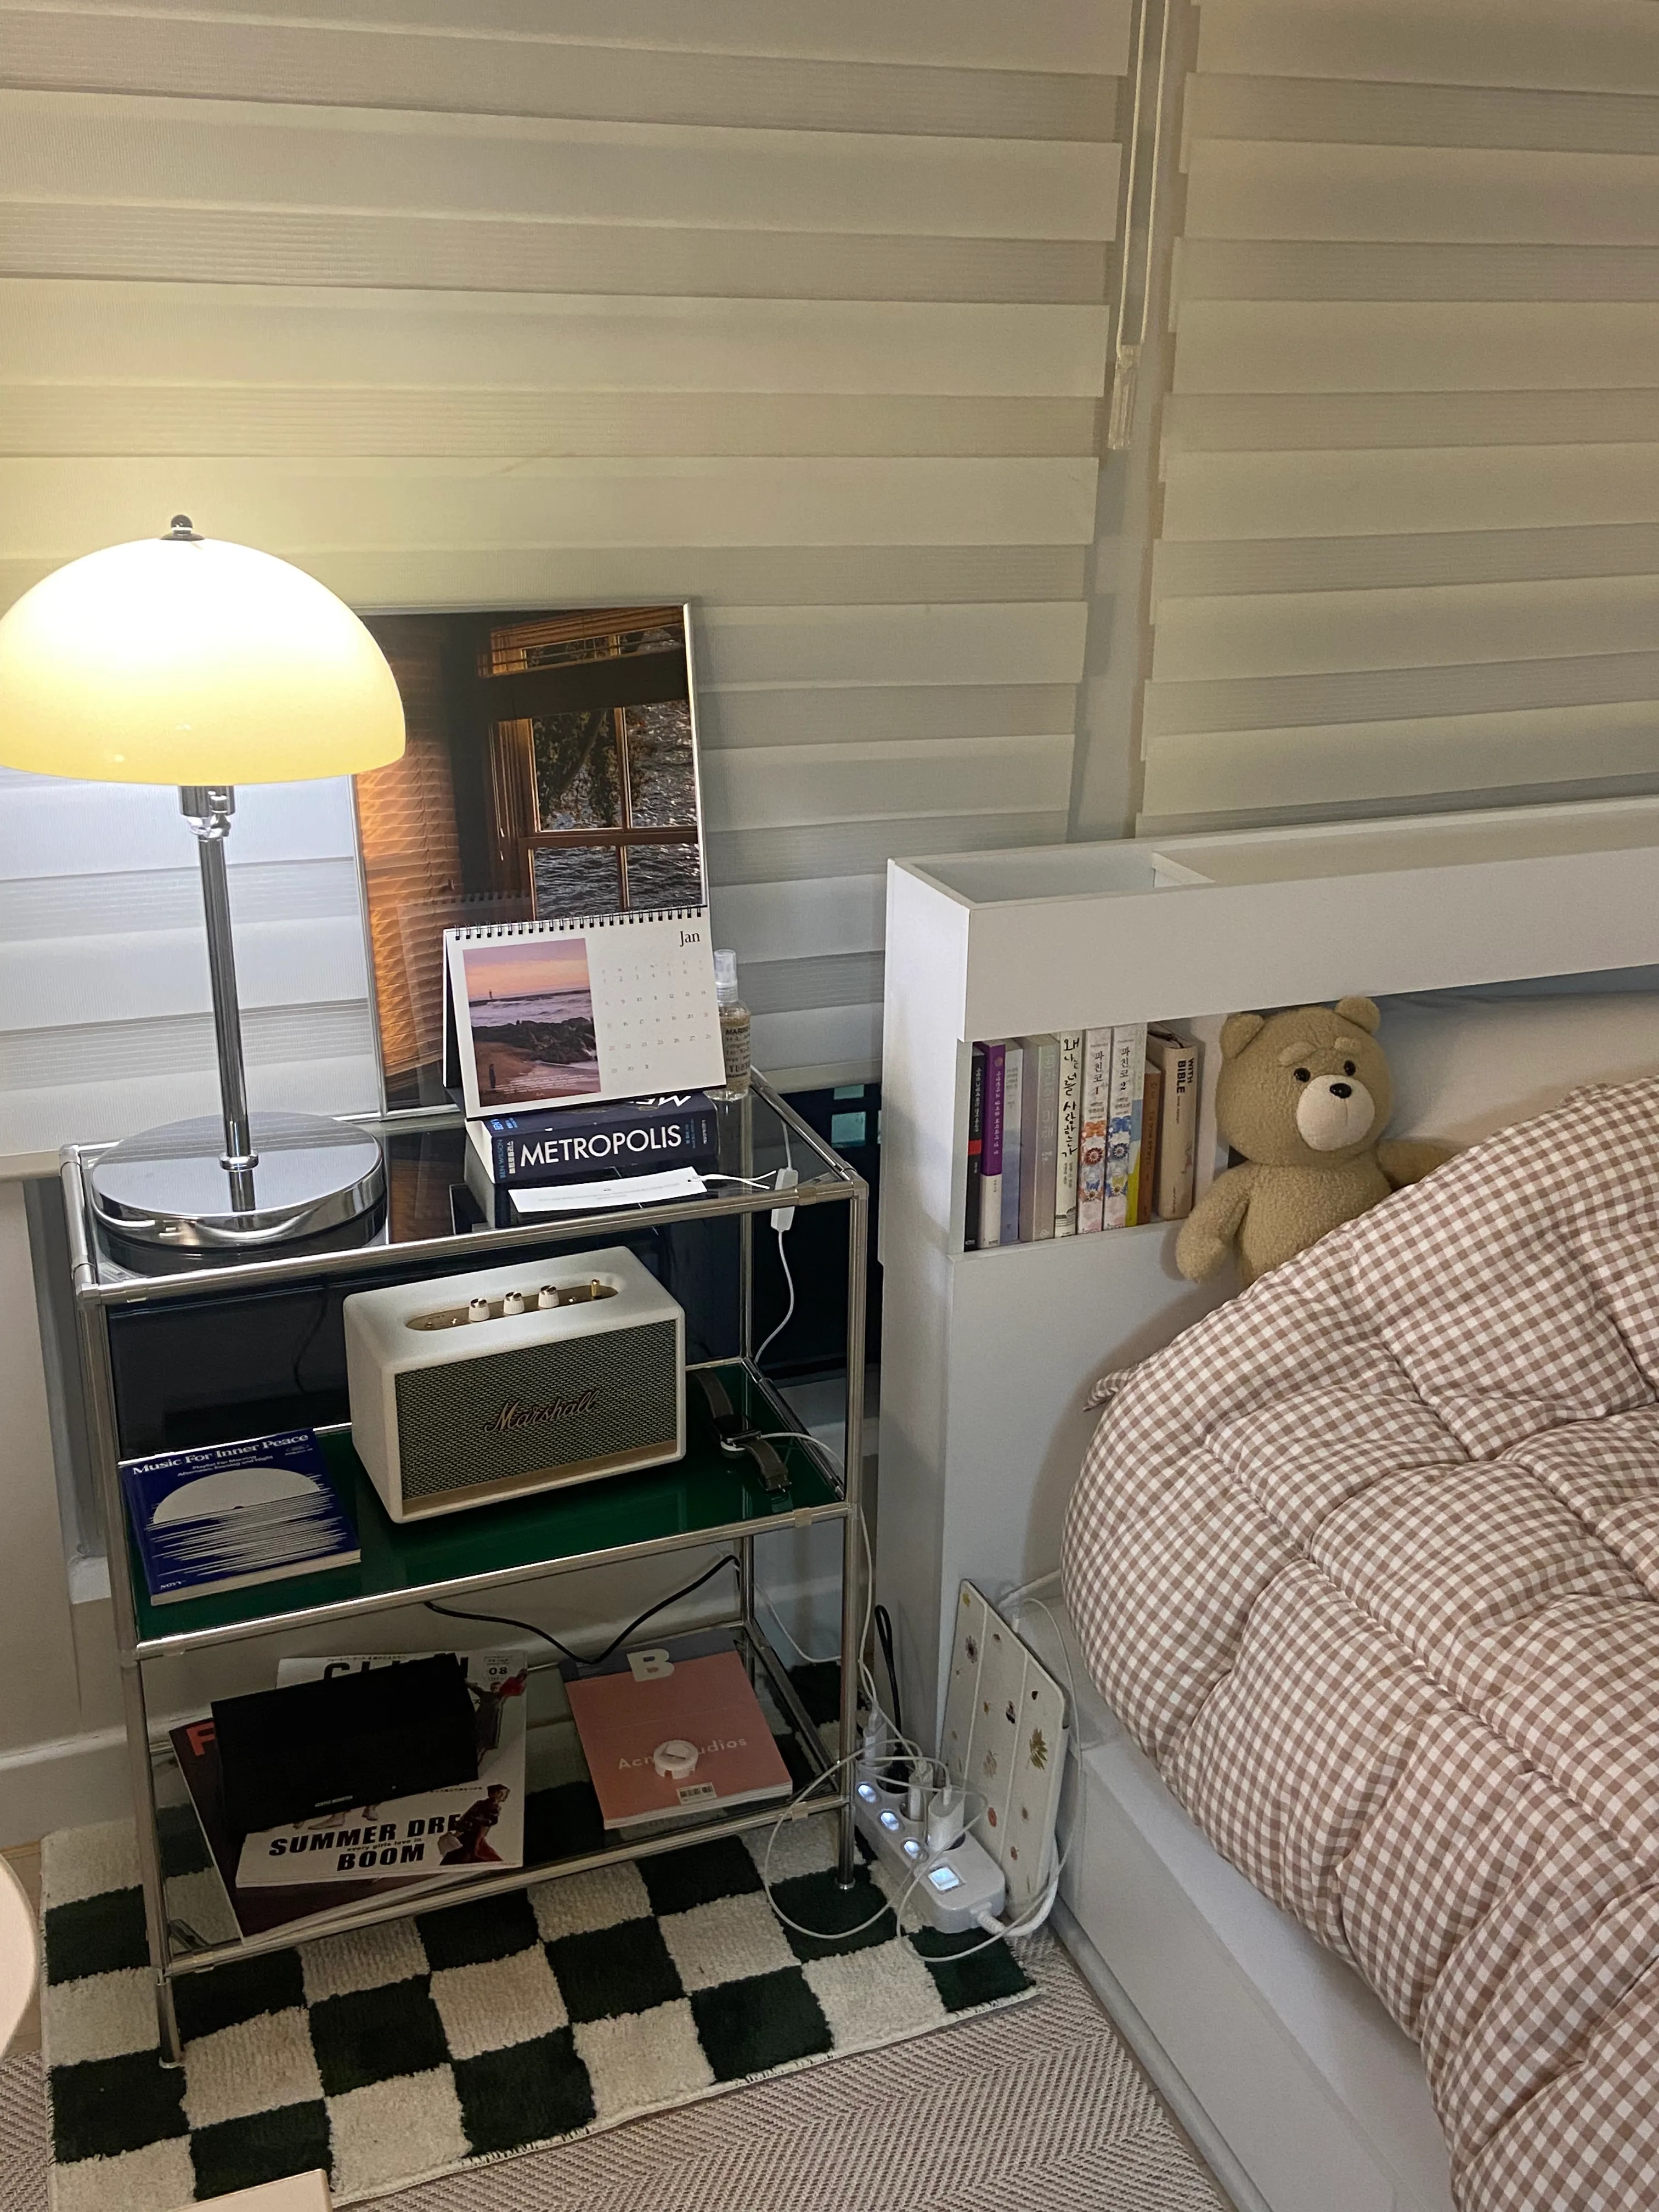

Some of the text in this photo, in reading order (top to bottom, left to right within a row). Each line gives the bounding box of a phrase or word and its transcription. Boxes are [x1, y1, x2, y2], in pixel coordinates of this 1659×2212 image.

[679, 930, 701, 947] Jan
[1063, 1037, 1080, 1051] 왜
[1064, 1053, 1079, 1069] 나는
[1093, 1050, 1104, 1083] 파친코
[1119, 1046, 1131, 1078] 파친코
[1176, 1060, 1186, 1093] BIBLE
[1187, 1057, 1195, 1084] WITH
[1063, 1072, 1077, 1096] 너를
[1120, 1081, 1127, 1091] 2
[1062, 1101, 1078, 1158] 사랑하는가
[520, 1125, 682, 1167] METROPOLIS
[484, 1389, 601, 1433] Marshall
[132, 1434, 309, 1475] Music For Inner Peace
[489, 1666, 507, 1675] 08
[627, 1648, 675, 1683] B
[618, 1737, 747, 1770] Acn udios
[269, 1822, 397, 1857] SUMMER
[336, 1843, 425, 1872] BOOM
